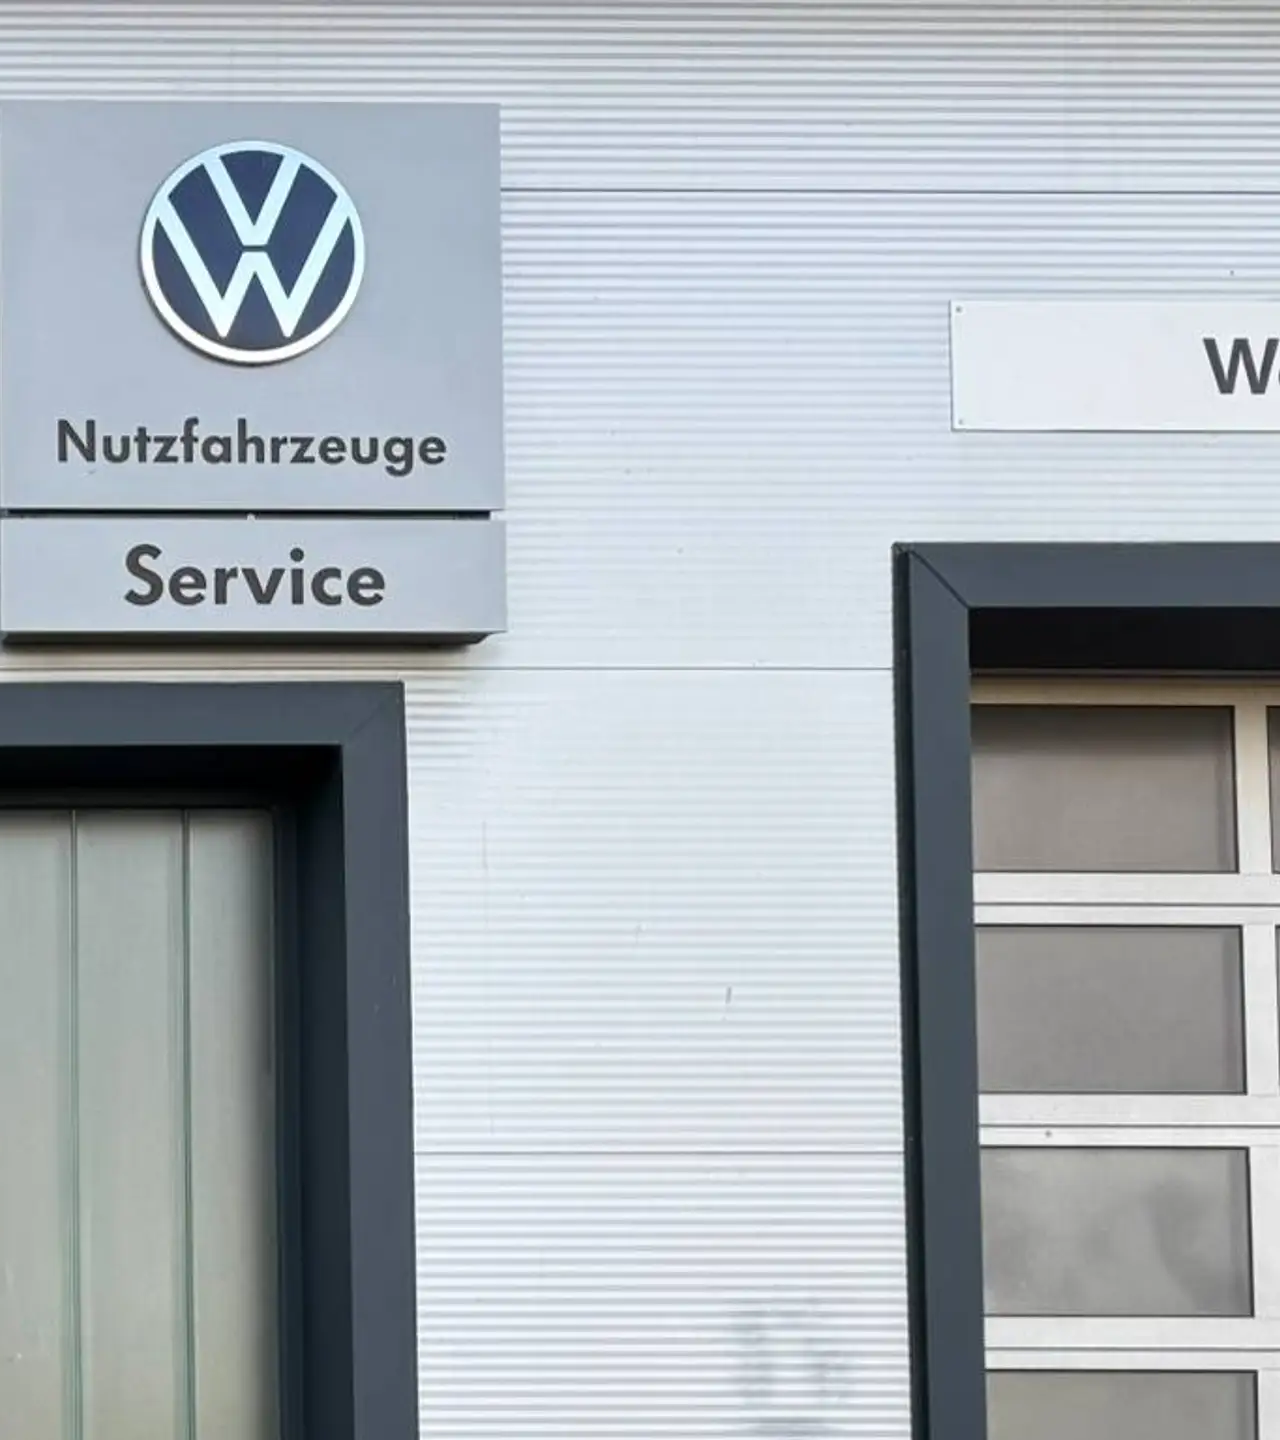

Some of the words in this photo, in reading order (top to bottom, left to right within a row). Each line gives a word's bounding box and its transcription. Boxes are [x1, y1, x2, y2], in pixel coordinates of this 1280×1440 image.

[149, 148, 355, 338] VW
[1202, 337, 1280, 395] W
[57, 417, 447, 477] Nutzfahrzeuge
[123, 543, 386, 606] Service
